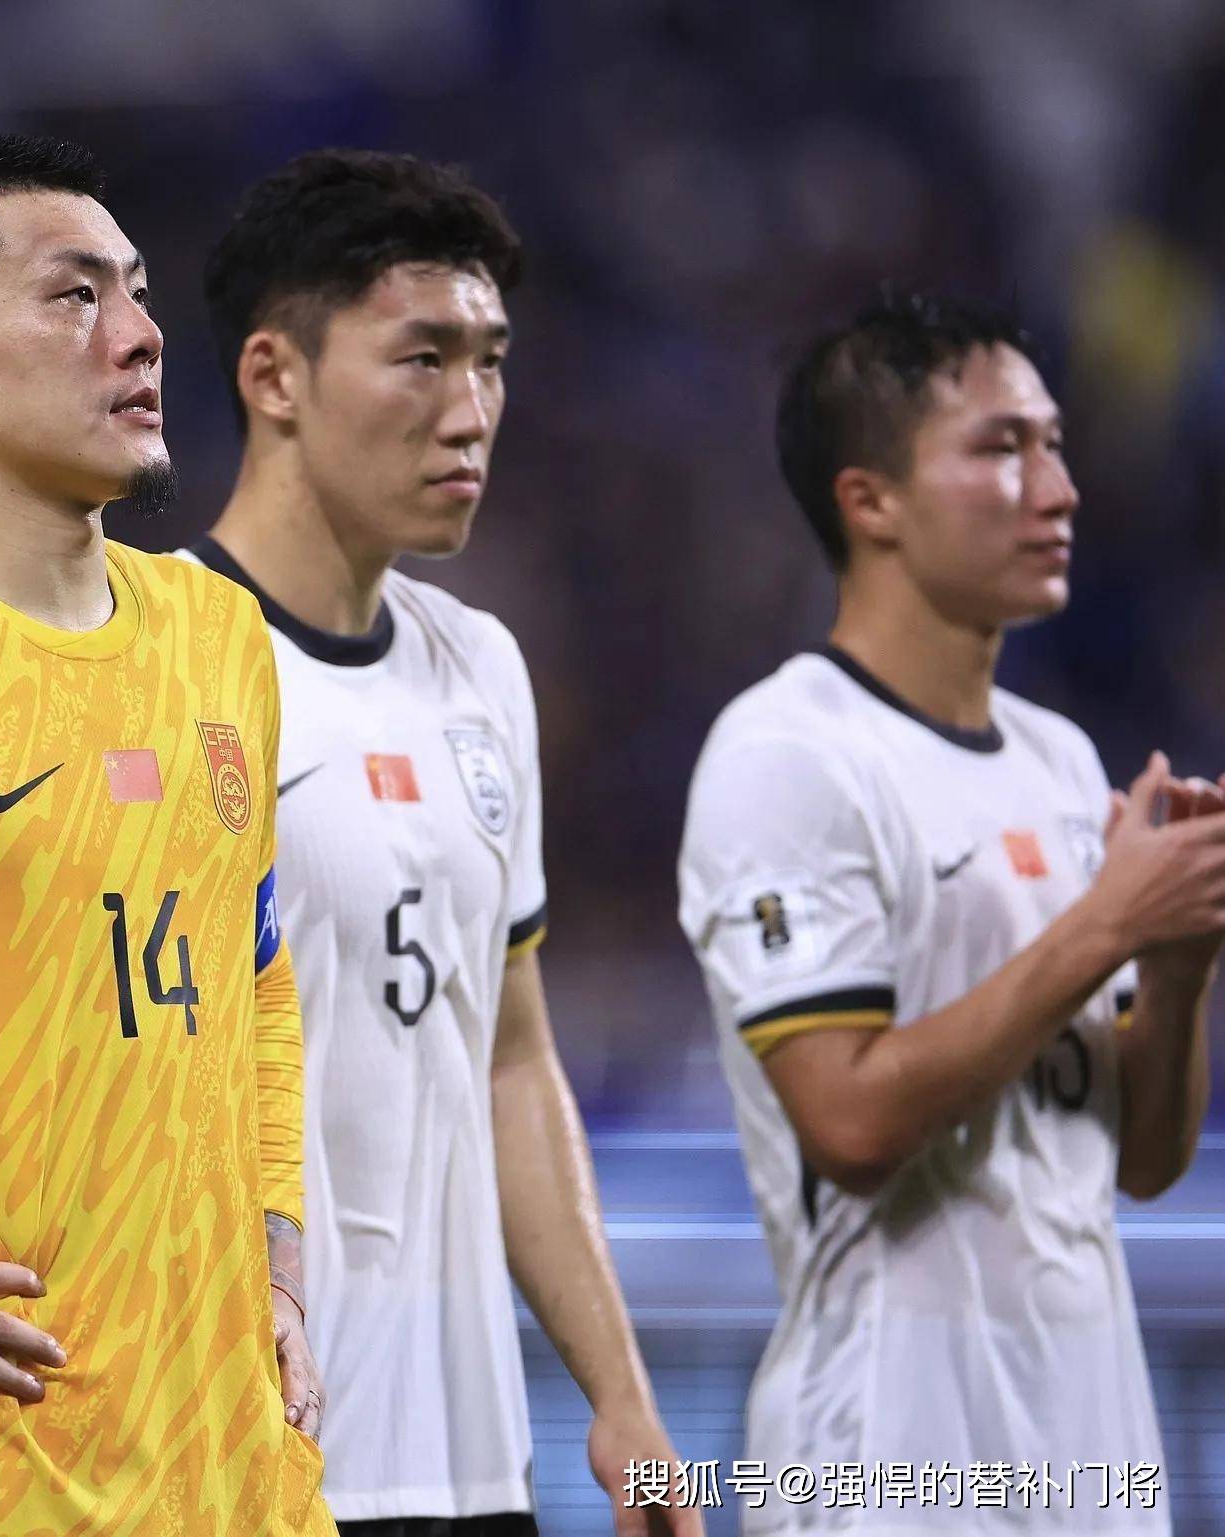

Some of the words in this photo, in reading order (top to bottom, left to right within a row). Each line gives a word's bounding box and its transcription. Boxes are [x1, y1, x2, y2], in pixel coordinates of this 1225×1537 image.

[201, 726, 240, 749] CFA
[102, 890, 200, 1038] 14
[385, 888, 436, 1027] 5
